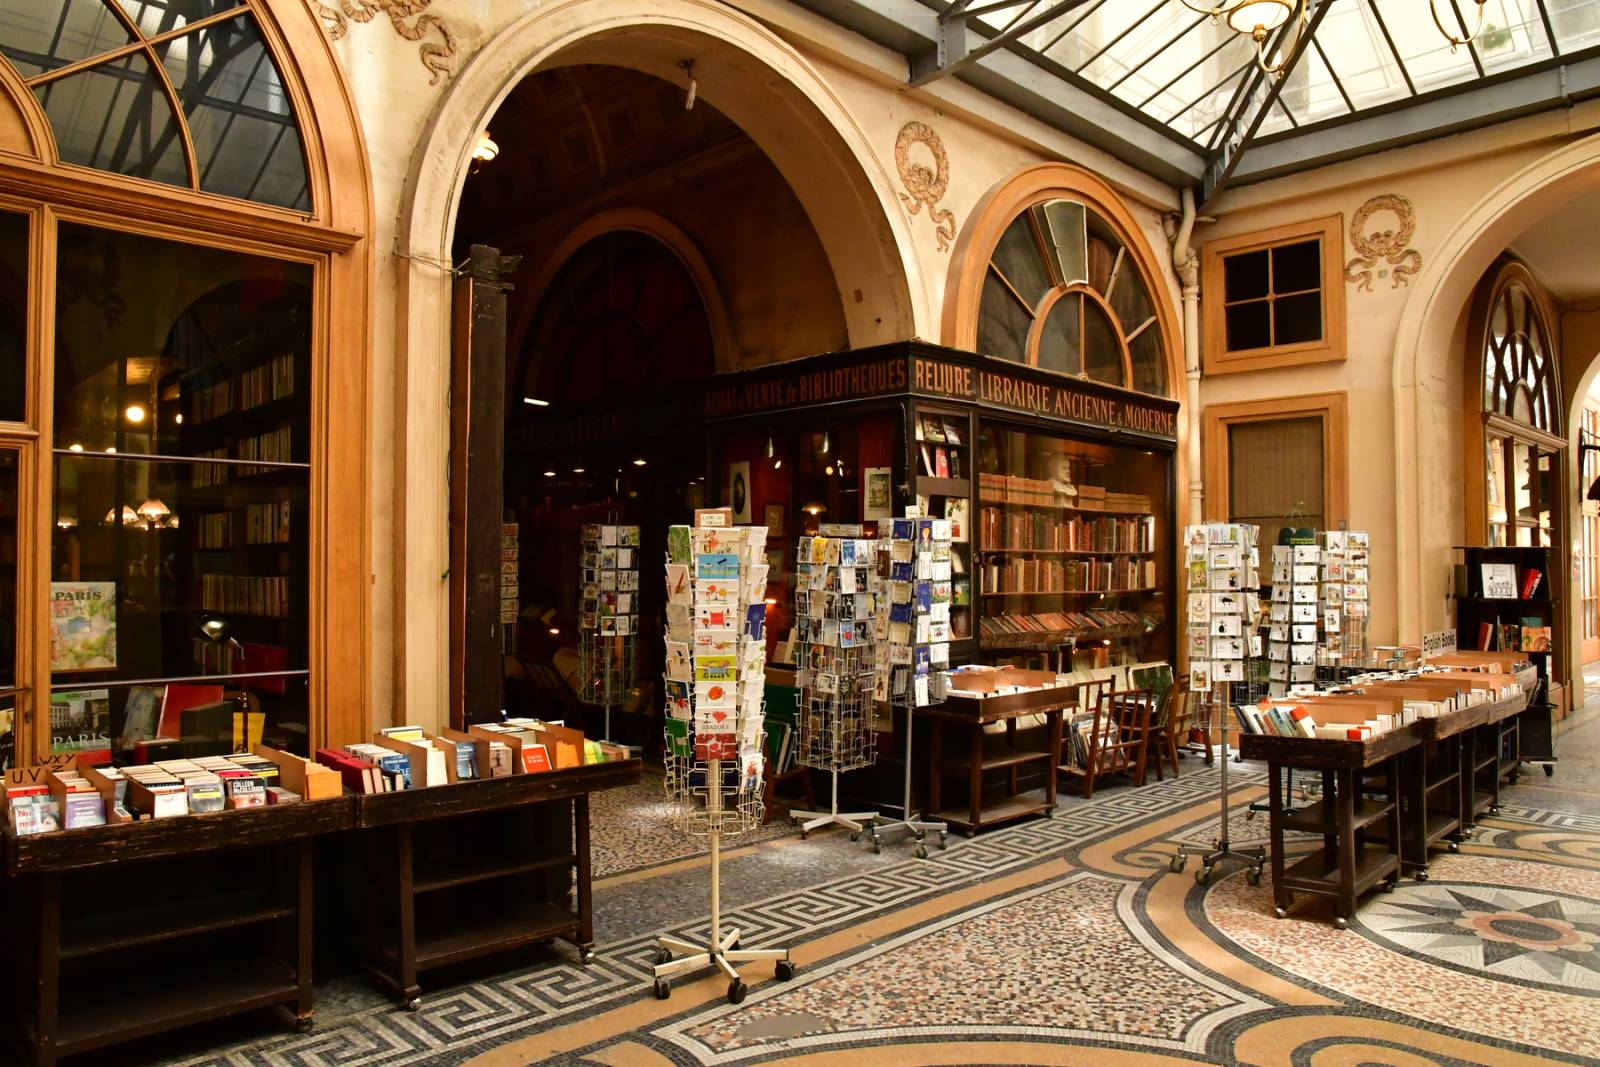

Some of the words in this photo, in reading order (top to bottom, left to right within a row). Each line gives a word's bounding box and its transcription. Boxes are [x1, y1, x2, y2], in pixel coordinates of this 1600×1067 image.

[916, 359, 973, 397] RELIURE
[979, 371, 1050, 413] LIBRAIRIE
[1054, 390, 1116, 426] ANCIENNE
[1125, 403, 1176, 437] MODERNE
[55, 591, 102, 600] PARIS
[1424, 634, 1441, 654] English
[1441, 632, 1455, 647] Books
[53, 731, 109, 750] PARIS
